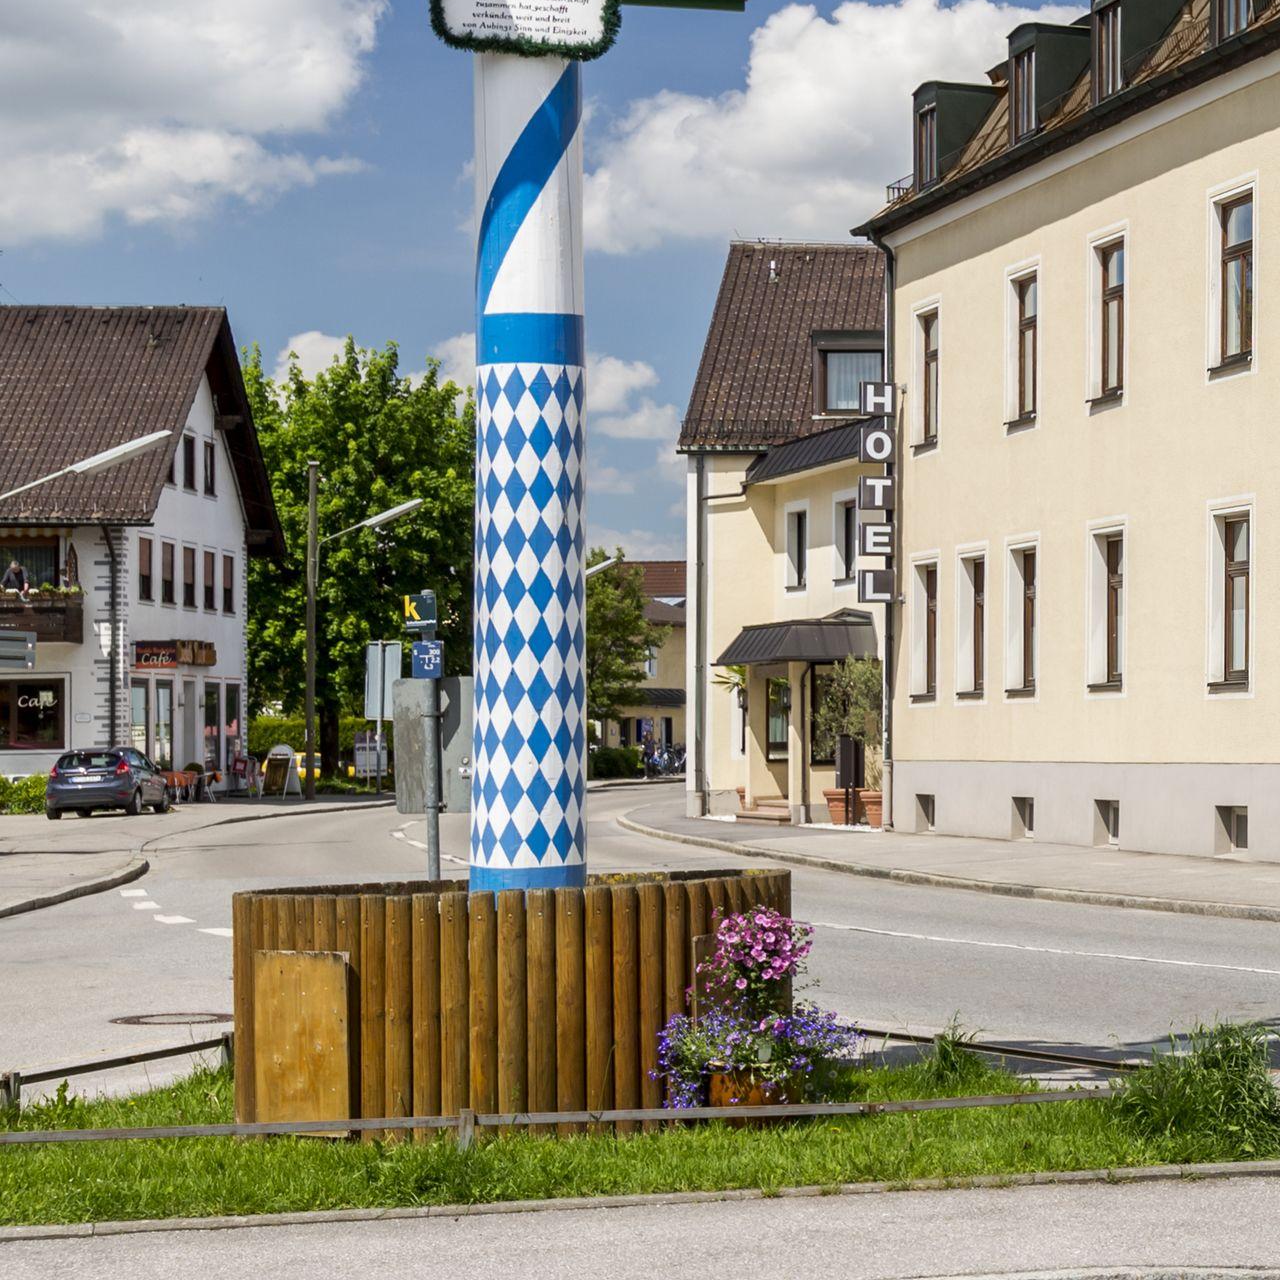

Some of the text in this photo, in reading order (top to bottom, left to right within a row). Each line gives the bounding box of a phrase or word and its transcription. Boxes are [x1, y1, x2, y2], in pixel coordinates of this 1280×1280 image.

[475, 1, 569, 14] zusammen hat geschafft
[535, 15, 551, 23] und
[552, 15, 570, 23] breit
[514, 24, 533, 33] Sinn
[552, 26, 588, 36] Einigkeit
[866, 384, 892, 600] HOTEL
[141, 650, 172, 667] Café
